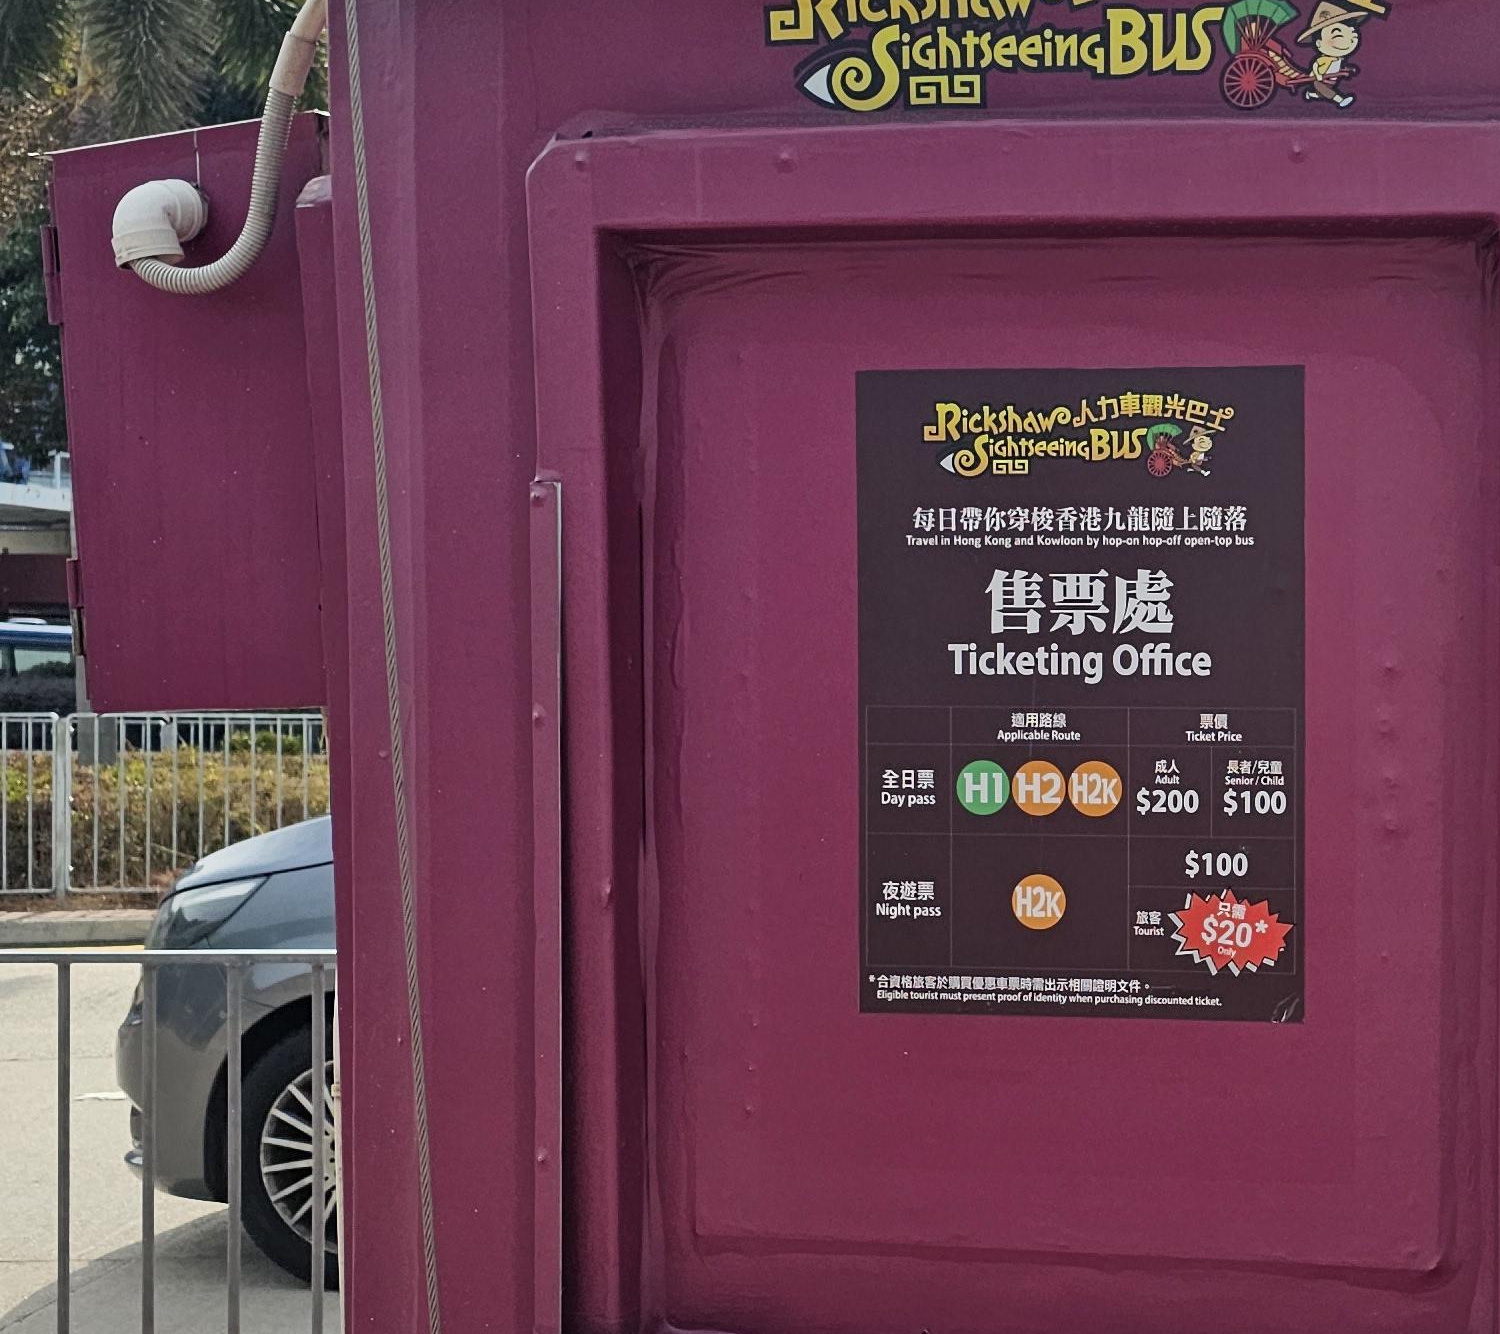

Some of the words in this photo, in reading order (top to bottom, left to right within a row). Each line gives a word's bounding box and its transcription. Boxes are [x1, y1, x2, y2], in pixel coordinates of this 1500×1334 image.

[829, 24, 1104, 112] Sightseeing
[1105, 7, 1225, 75] BUS
[1072, 391, 1235, 432] 人力車觀光巴士
[923, 402, 1072, 442] Rickshaw
[953, 434, 1090, 477] Sightseeing
[1089, 427, 1149, 461] BUS
[912, 506, 1248, 533] 每日帶你穿梭香港九龍隨上隨落
[906, 534, 939, 546] Travel
[940, 534, 950, 546] in
[953, 535, 982, 549] Hong
[984, 535, 1012, 549] Kong
[1014, 535, 1034, 546] and
[1036, 535, 1084, 547] Kowloon
[1086, 535, 1100, 549] by
[1102, 534, 1140, 548] hop-on
[1142, 534, 1182, 548] hop-off
[1184, 535, 1233, 549] open-top
[1234, 534, 1255, 546] bus
[984, 567, 1175, 635] 售票處
[947, 642, 1104, 685] Ticketing
[1112, 642, 1213, 677] Office
[1010, 712, 1067, 729] 適用路線
[1199, 713, 1229, 730] 票價
[997, 729, 1050, 743] Applicable
[1051, 730, 1081, 741] Route
[1185, 730, 1216, 742] Ticket
[1217, 731, 1243, 742] Price
[1154, 759, 1181, 774] 成人
[1226, 759, 1283, 775] 長者/兒童
[881, 769, 935, 790] 全日票
[963, 772, 1003, 804] H1
[1014, 772, 1062, 804] H2
[1154, 774, 1180, 785] Adult
[1224, 775, 1254, 786] Senior
[1260, 775, 1285, 786] Child
[881, 792, 907, 807] Day
[908, 794, 936, 807] pass
[1136, 787, 1200, 816] $200
[1223, 787, 1287, 817] $100
[1185, 849, 1249, 879] $100
[881, 880, 935, 901] 夜遊票
[875, 902, 911, 919] Night
[913, 904, 942, 919] pass
[1135, 910, 1162, 925] 旅客
[1216, 901, 1247, 920] 只需
[1132, 925, 1165, 936] Tourist
[1217, 945, 1237, 958] Only
[876, 990, 909, 1002] Eligible
[909, 990, 939, 1000] tourist
[939, 991, 962, 1001] must
[962, 992, 996, 1002] present
[997, 991, 1022, 1003] proof
[1022, 992, 1033, 1002] of
[1068, 994, 1094, 1004] when
[1094, 994, 1144, 1006] purchasing
[1144, 995, 1194, 1005] discounted
[1194, 996, 1223, 1007] ticket.
